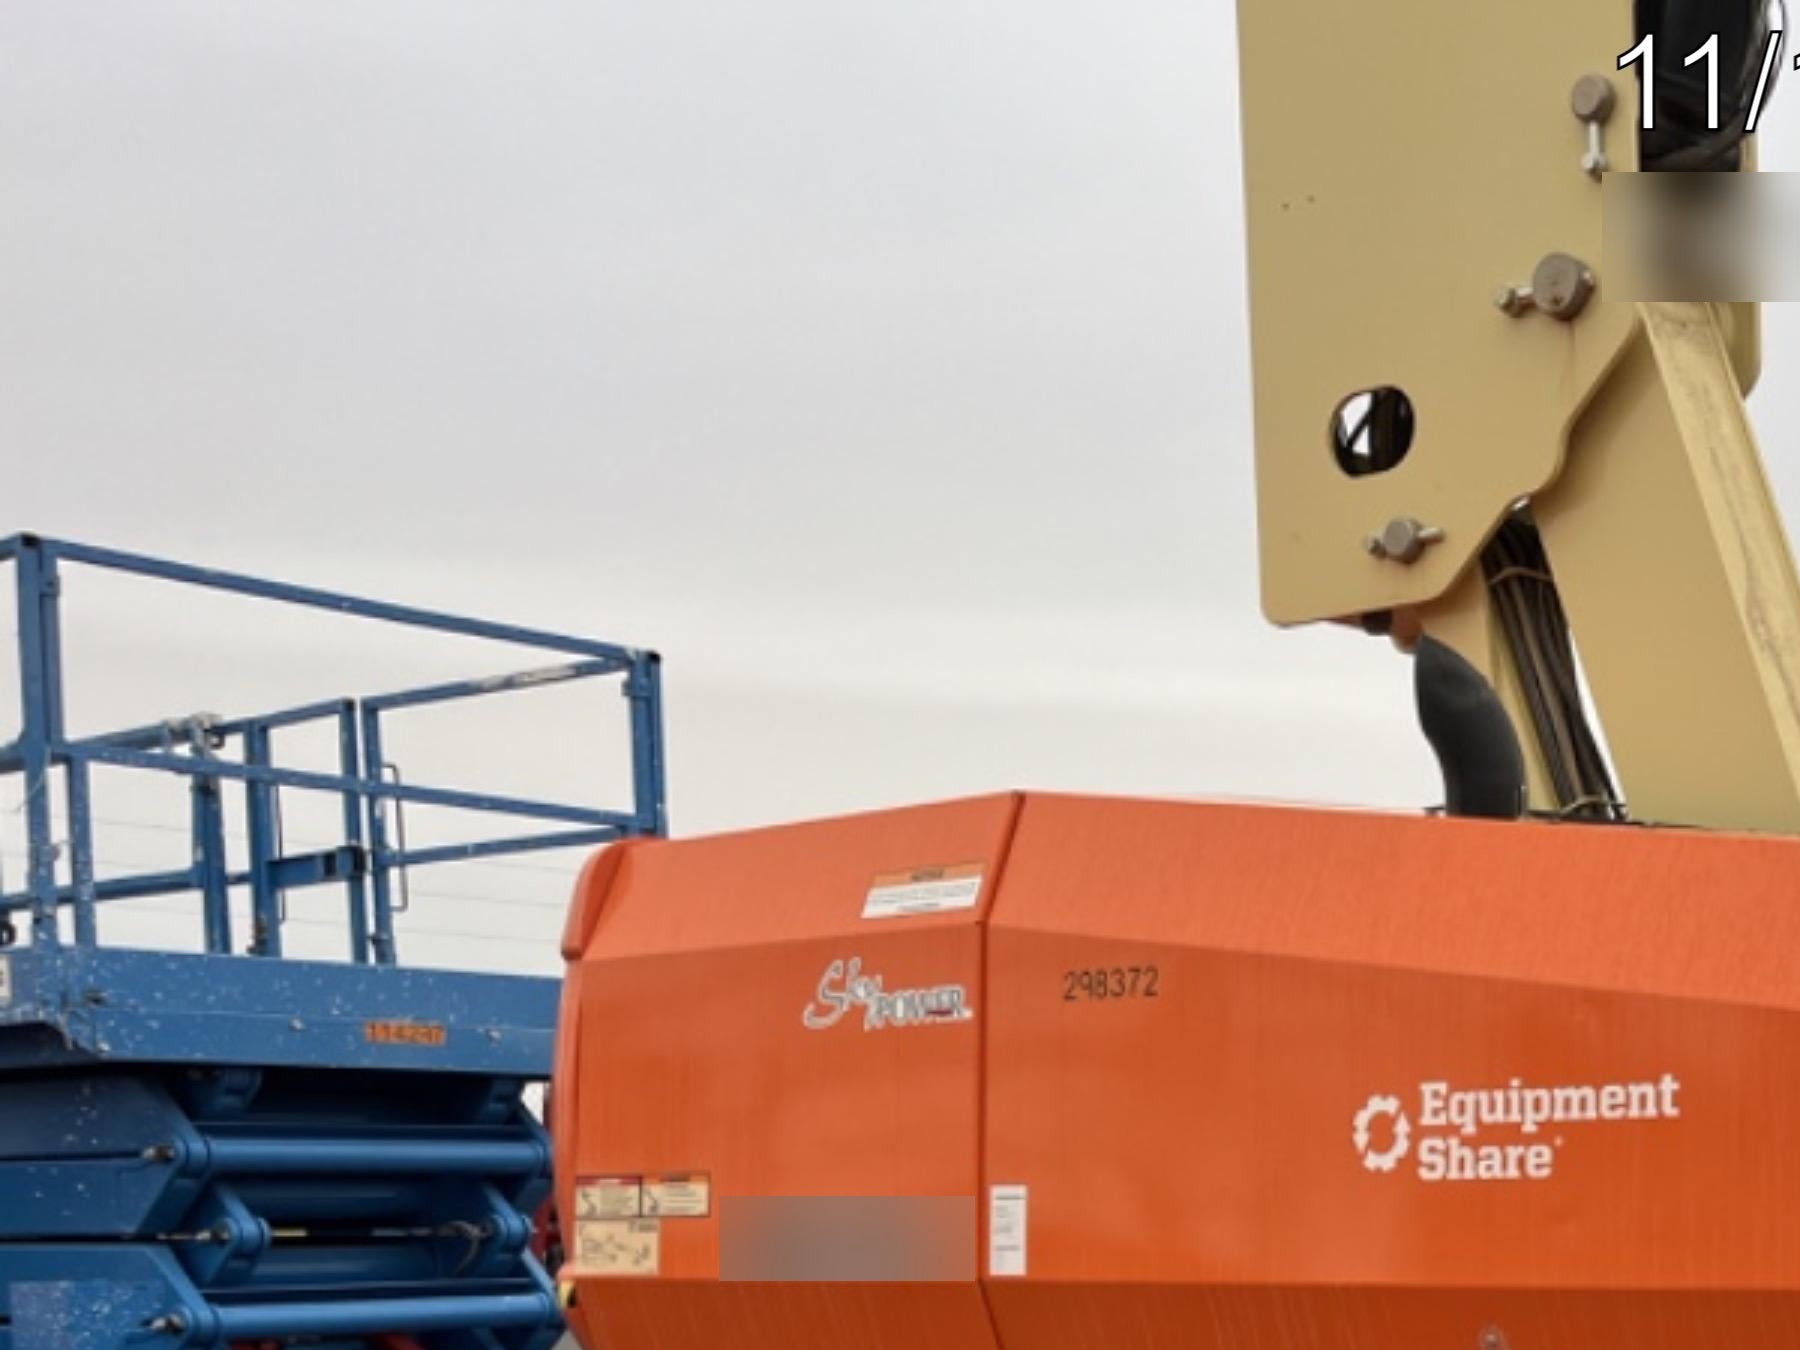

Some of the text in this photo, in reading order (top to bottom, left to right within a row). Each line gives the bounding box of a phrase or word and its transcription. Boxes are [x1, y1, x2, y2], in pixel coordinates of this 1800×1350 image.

[1063, 965, 1160, 1002] 298372
[1418, 1072, 1682, 1135] Equipment
[1416, 1136, 1554, 1182] Share
